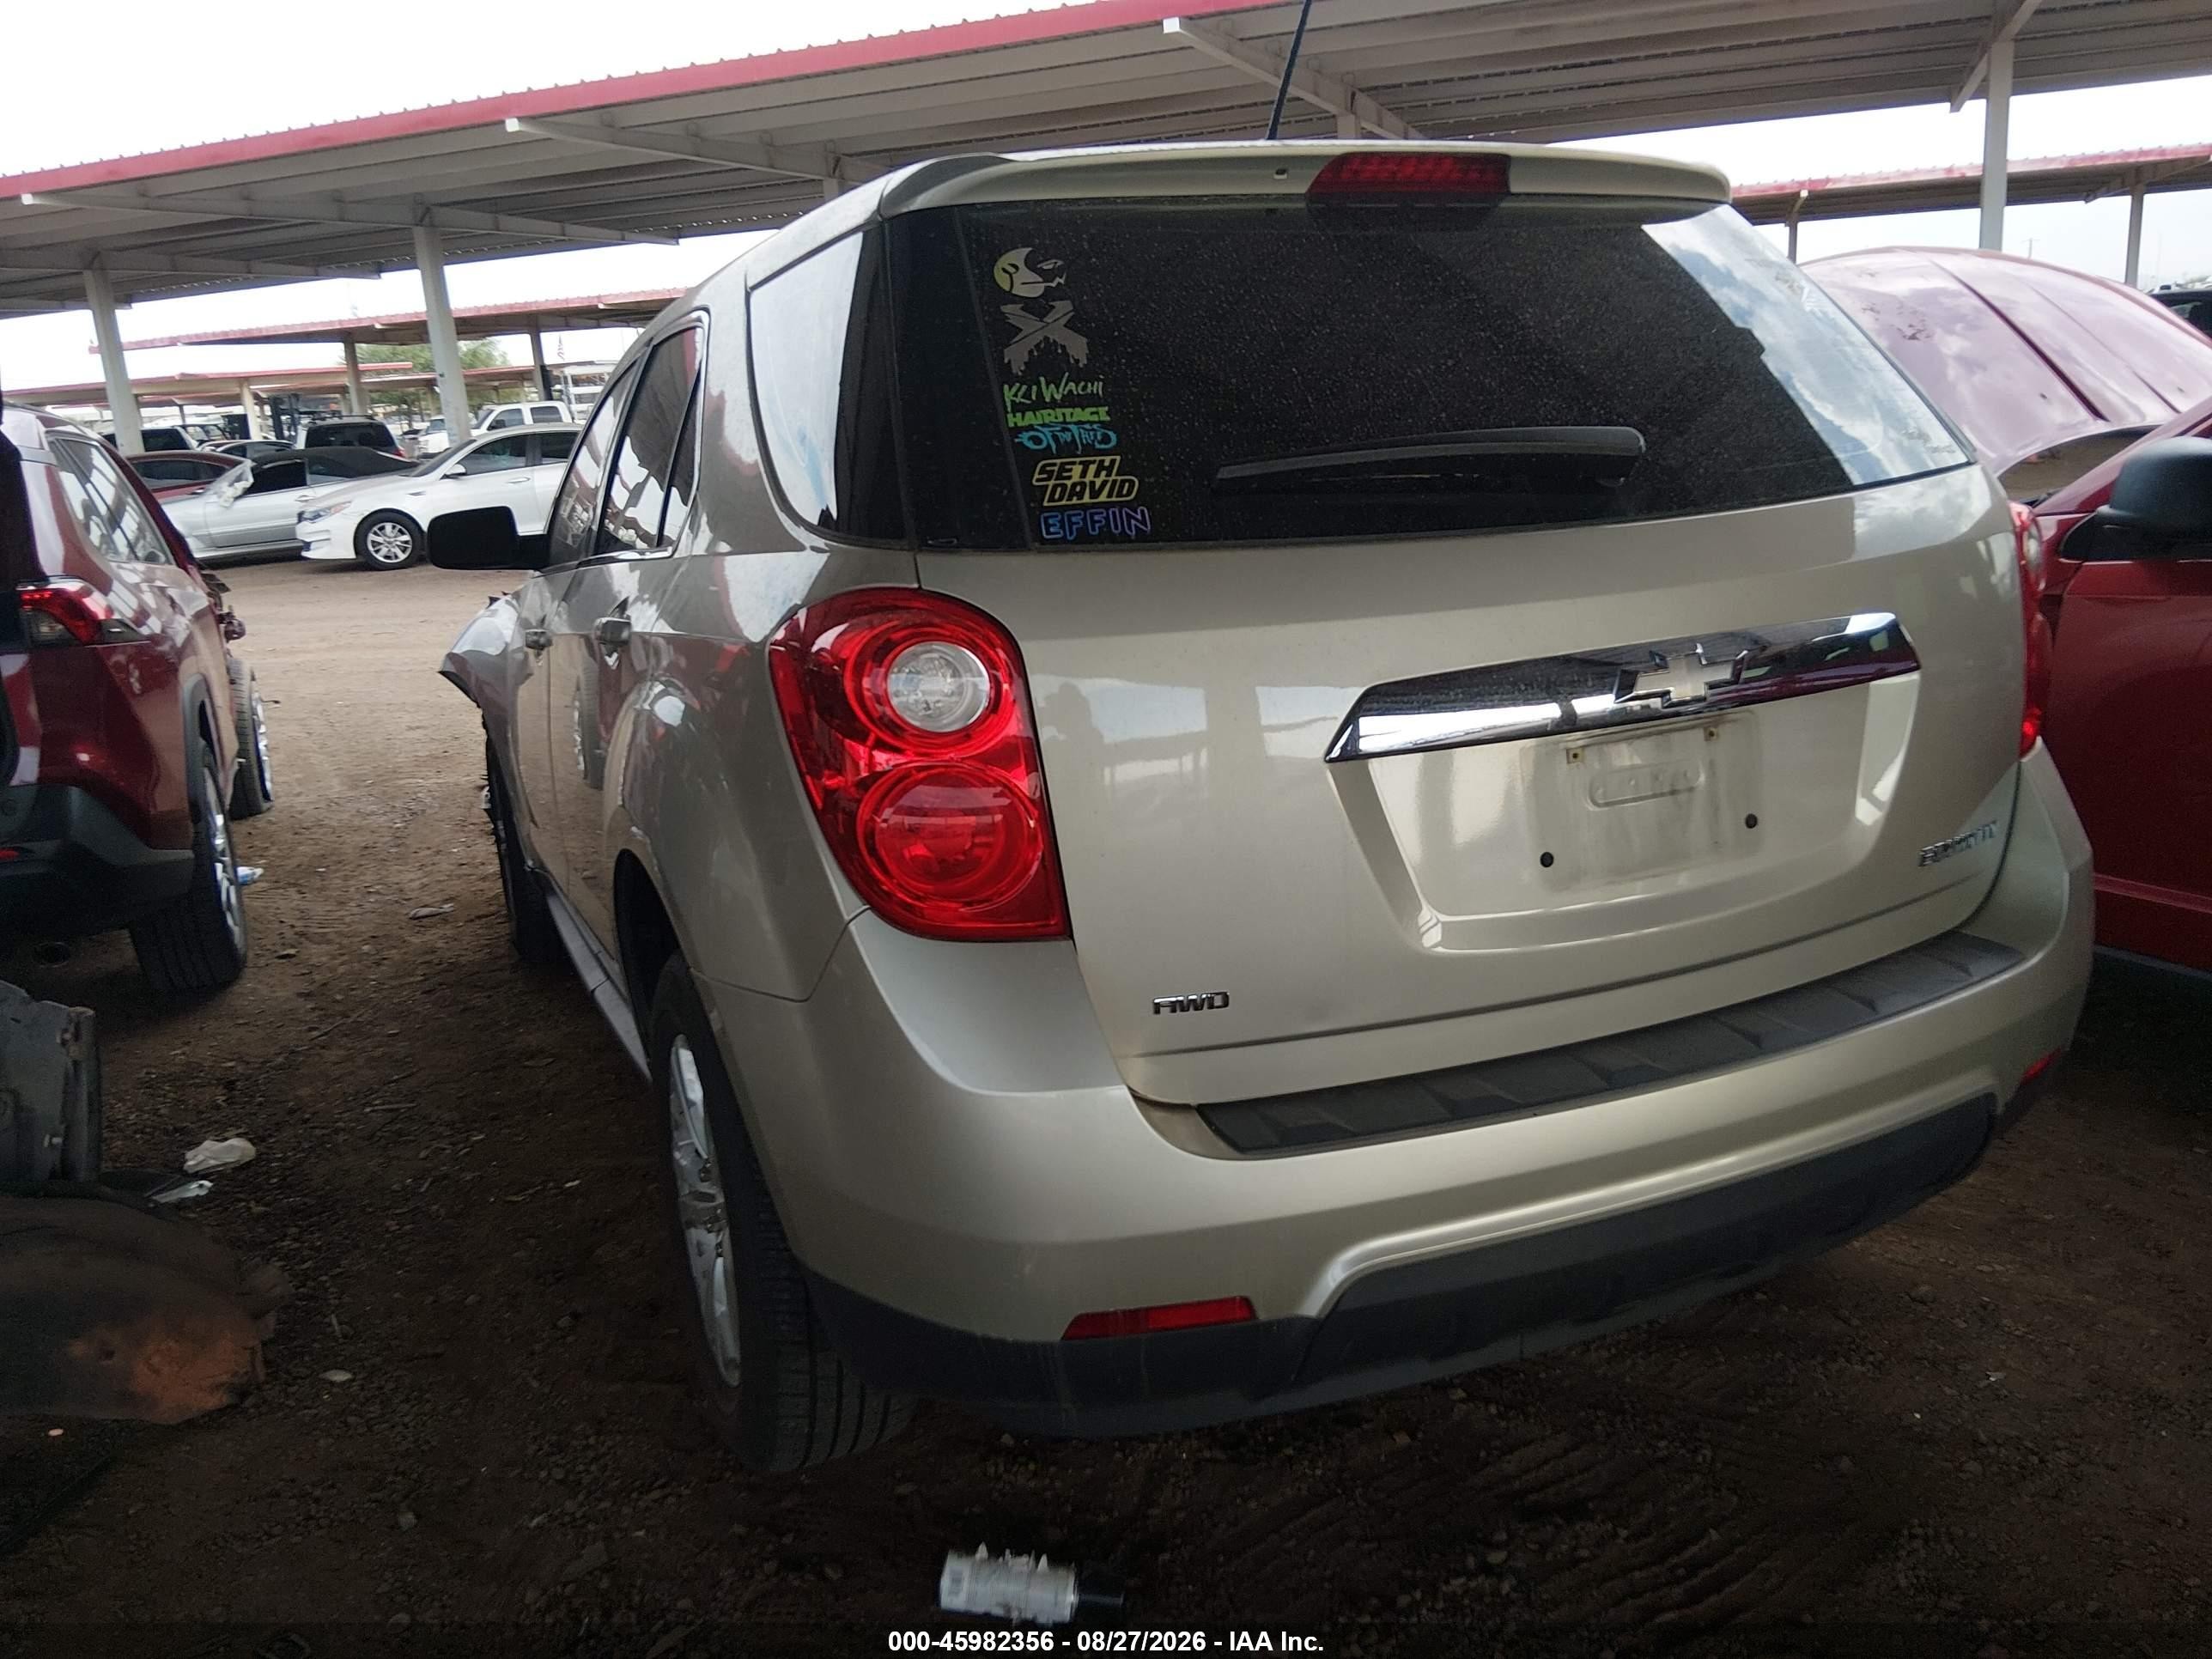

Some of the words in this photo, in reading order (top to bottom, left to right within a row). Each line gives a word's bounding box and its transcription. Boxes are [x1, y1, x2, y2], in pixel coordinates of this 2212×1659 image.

[1035, 458, 1118, 483] SETH
[1046, 477, 1137, 504] DAVID
[1040, 507, 1152, 540] EFFIN
[1152, 992, 1230, 1015] AWD
